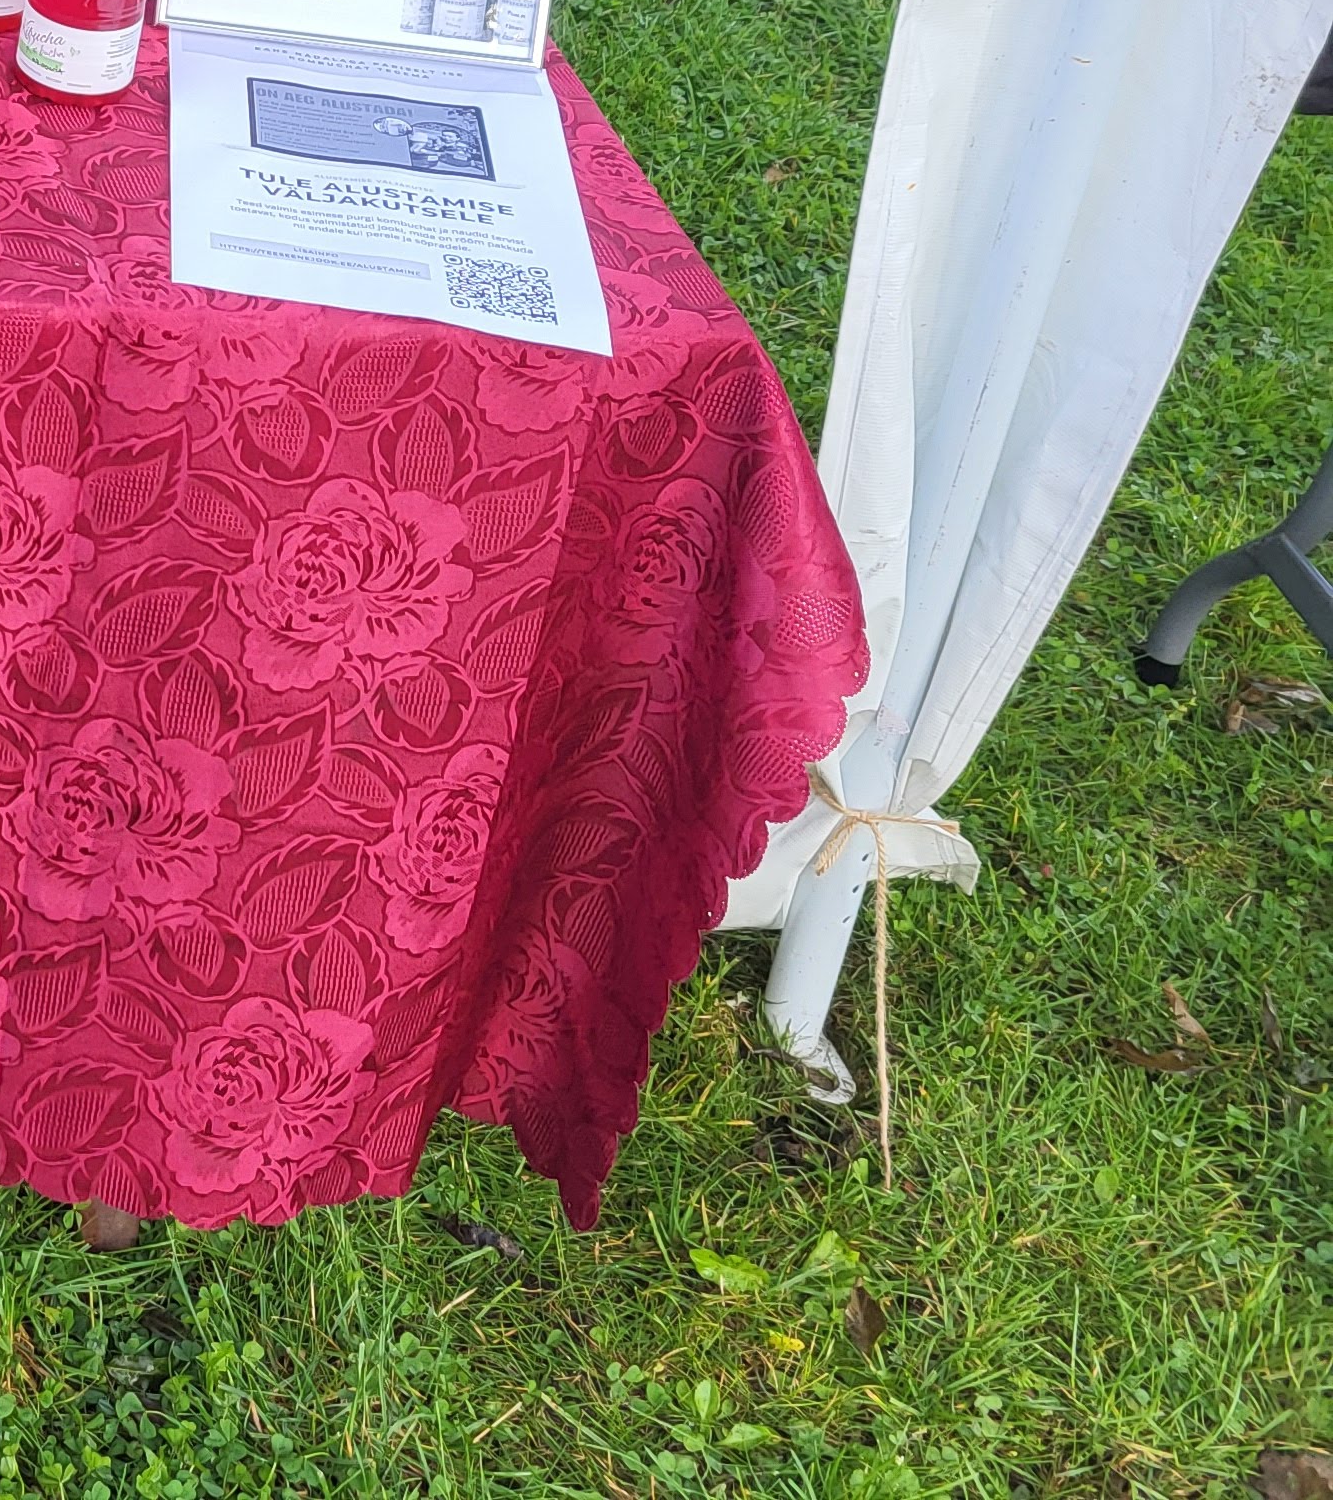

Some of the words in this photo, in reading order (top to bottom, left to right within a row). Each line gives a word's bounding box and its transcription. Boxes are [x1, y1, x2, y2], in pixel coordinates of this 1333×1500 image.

[239, 167, 311, 188] TULE
[322, 182, 514, 216] ALUSTAMISE
[261, 184, 494, 225] VÄLJAKUTSELE
